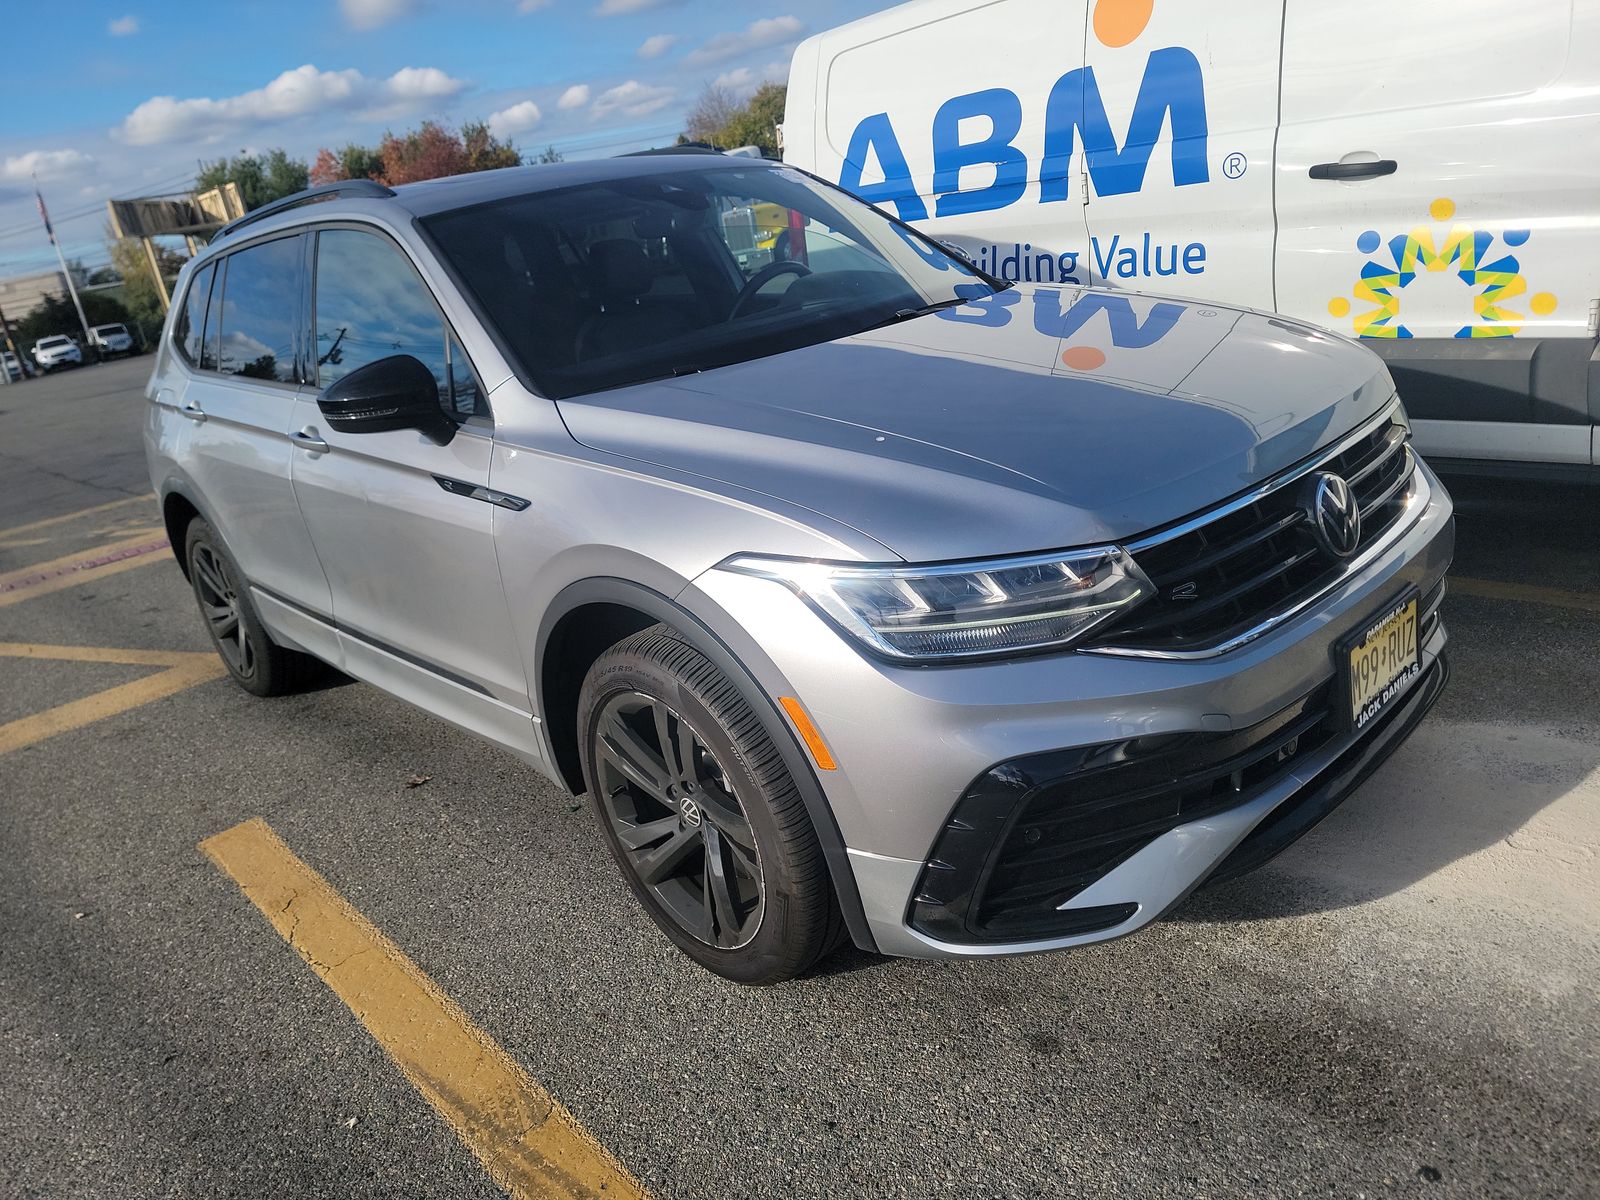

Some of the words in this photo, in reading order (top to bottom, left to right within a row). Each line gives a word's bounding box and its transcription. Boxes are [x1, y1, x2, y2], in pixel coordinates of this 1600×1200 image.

[838, 46, 1210, 222] ABM
[970, 243, 1079, 284] ilding
[1091, 232, 1207, 279] Value
[1357, 697, 1381, 728] JACK
[1382, 662, 1419, 704] DANIELS
